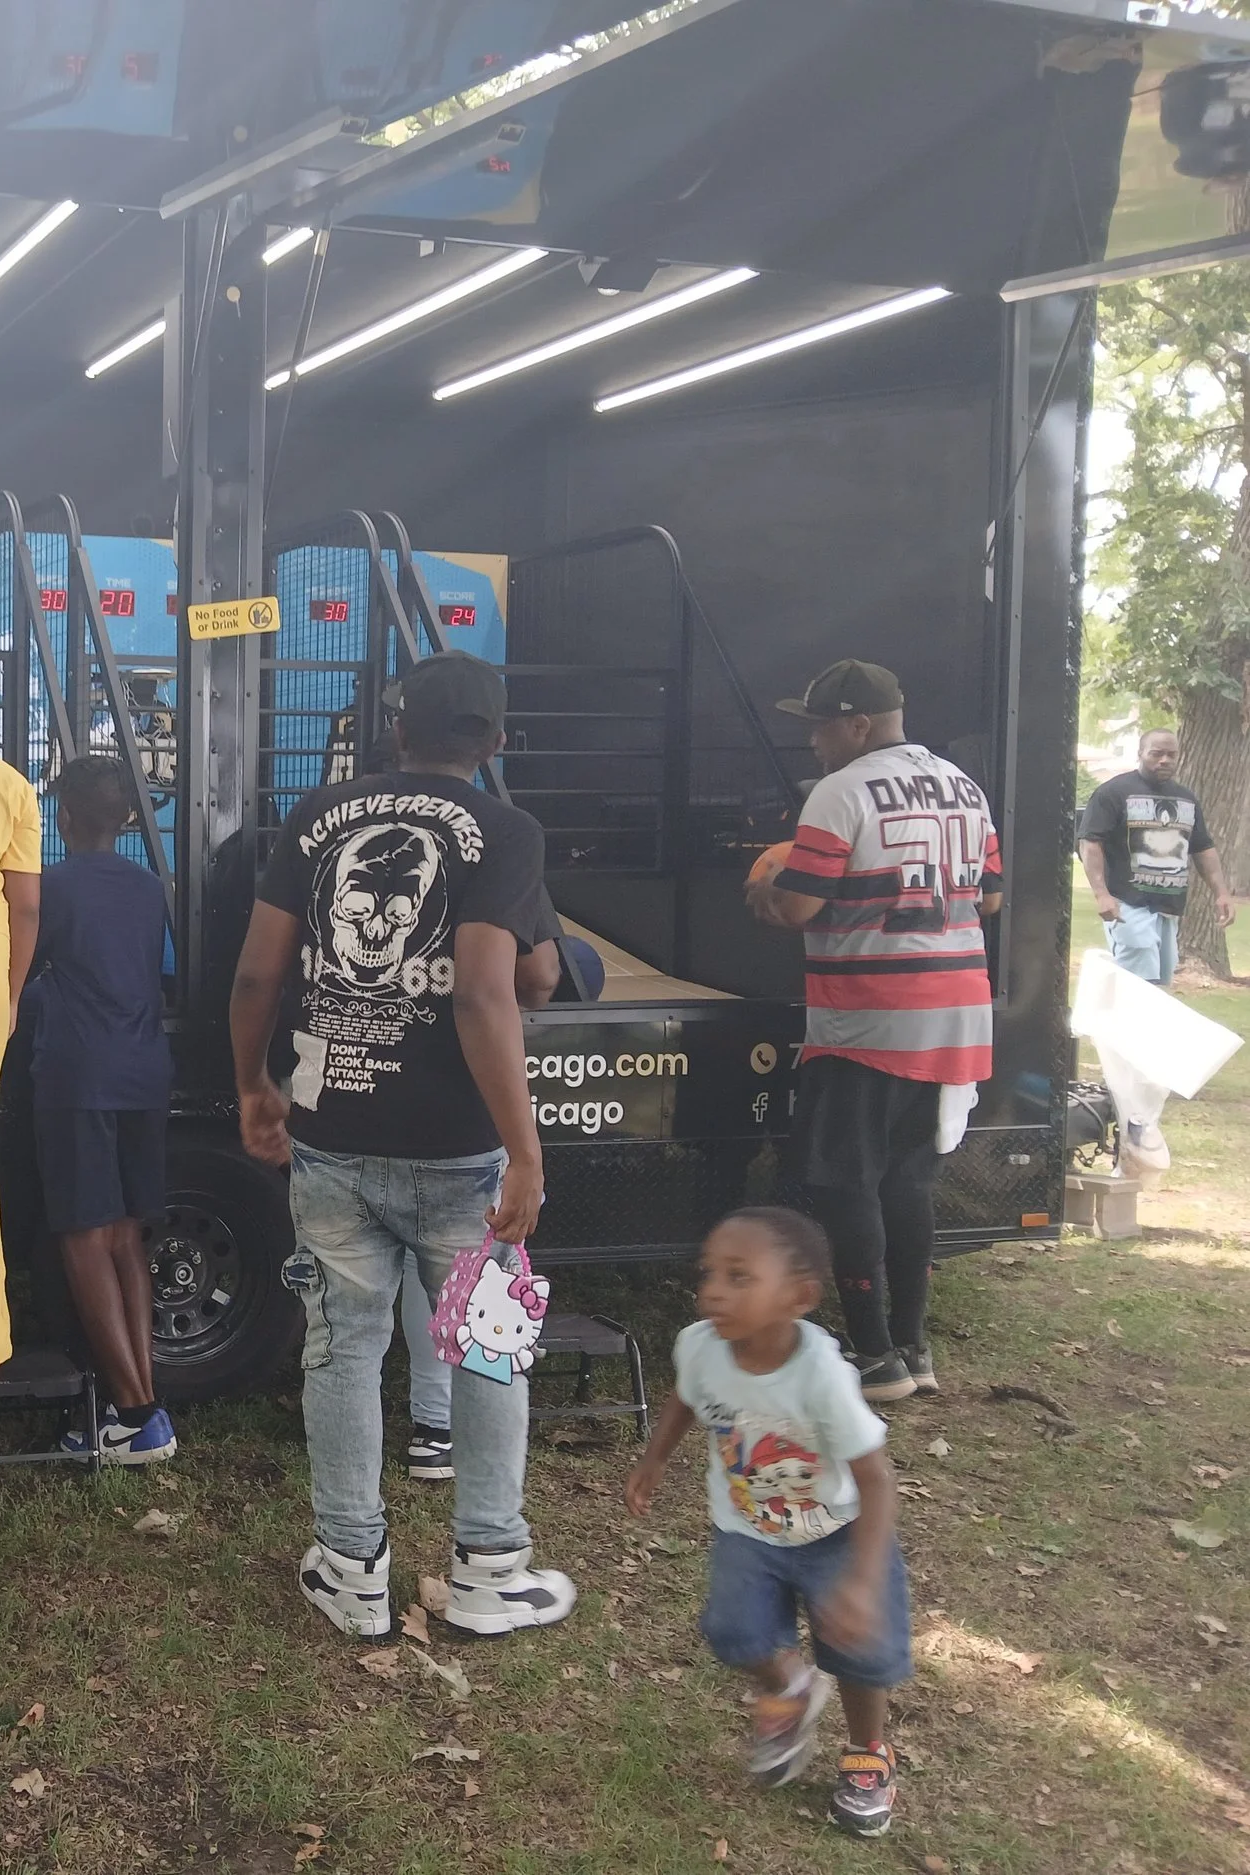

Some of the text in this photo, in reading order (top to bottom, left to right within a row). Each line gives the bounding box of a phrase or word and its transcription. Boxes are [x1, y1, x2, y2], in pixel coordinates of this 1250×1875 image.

[105, 577, 131, 588] TIME
[41, 591, 66, 610] 30
[101, 591, 134, 615] 20
[439, 591, 475, 601] SCORE
[195, 607, 239, 620] No Food
[324, 602, 347, 621] 30
[451, 608, 475, 626] 24
[198, 619, 240, 632] or Drink
[330, 1043, 369, 1058] DON'T
[328, 1055, 402, 1073] LOOK BACK
[525, 1052, 689, 1088] cago.com
[326, 1066, 374, 1081] ATTACK
[325, 1077, 377, 1094] & ADAPT
[531, 1095, 624, 1135] icago
